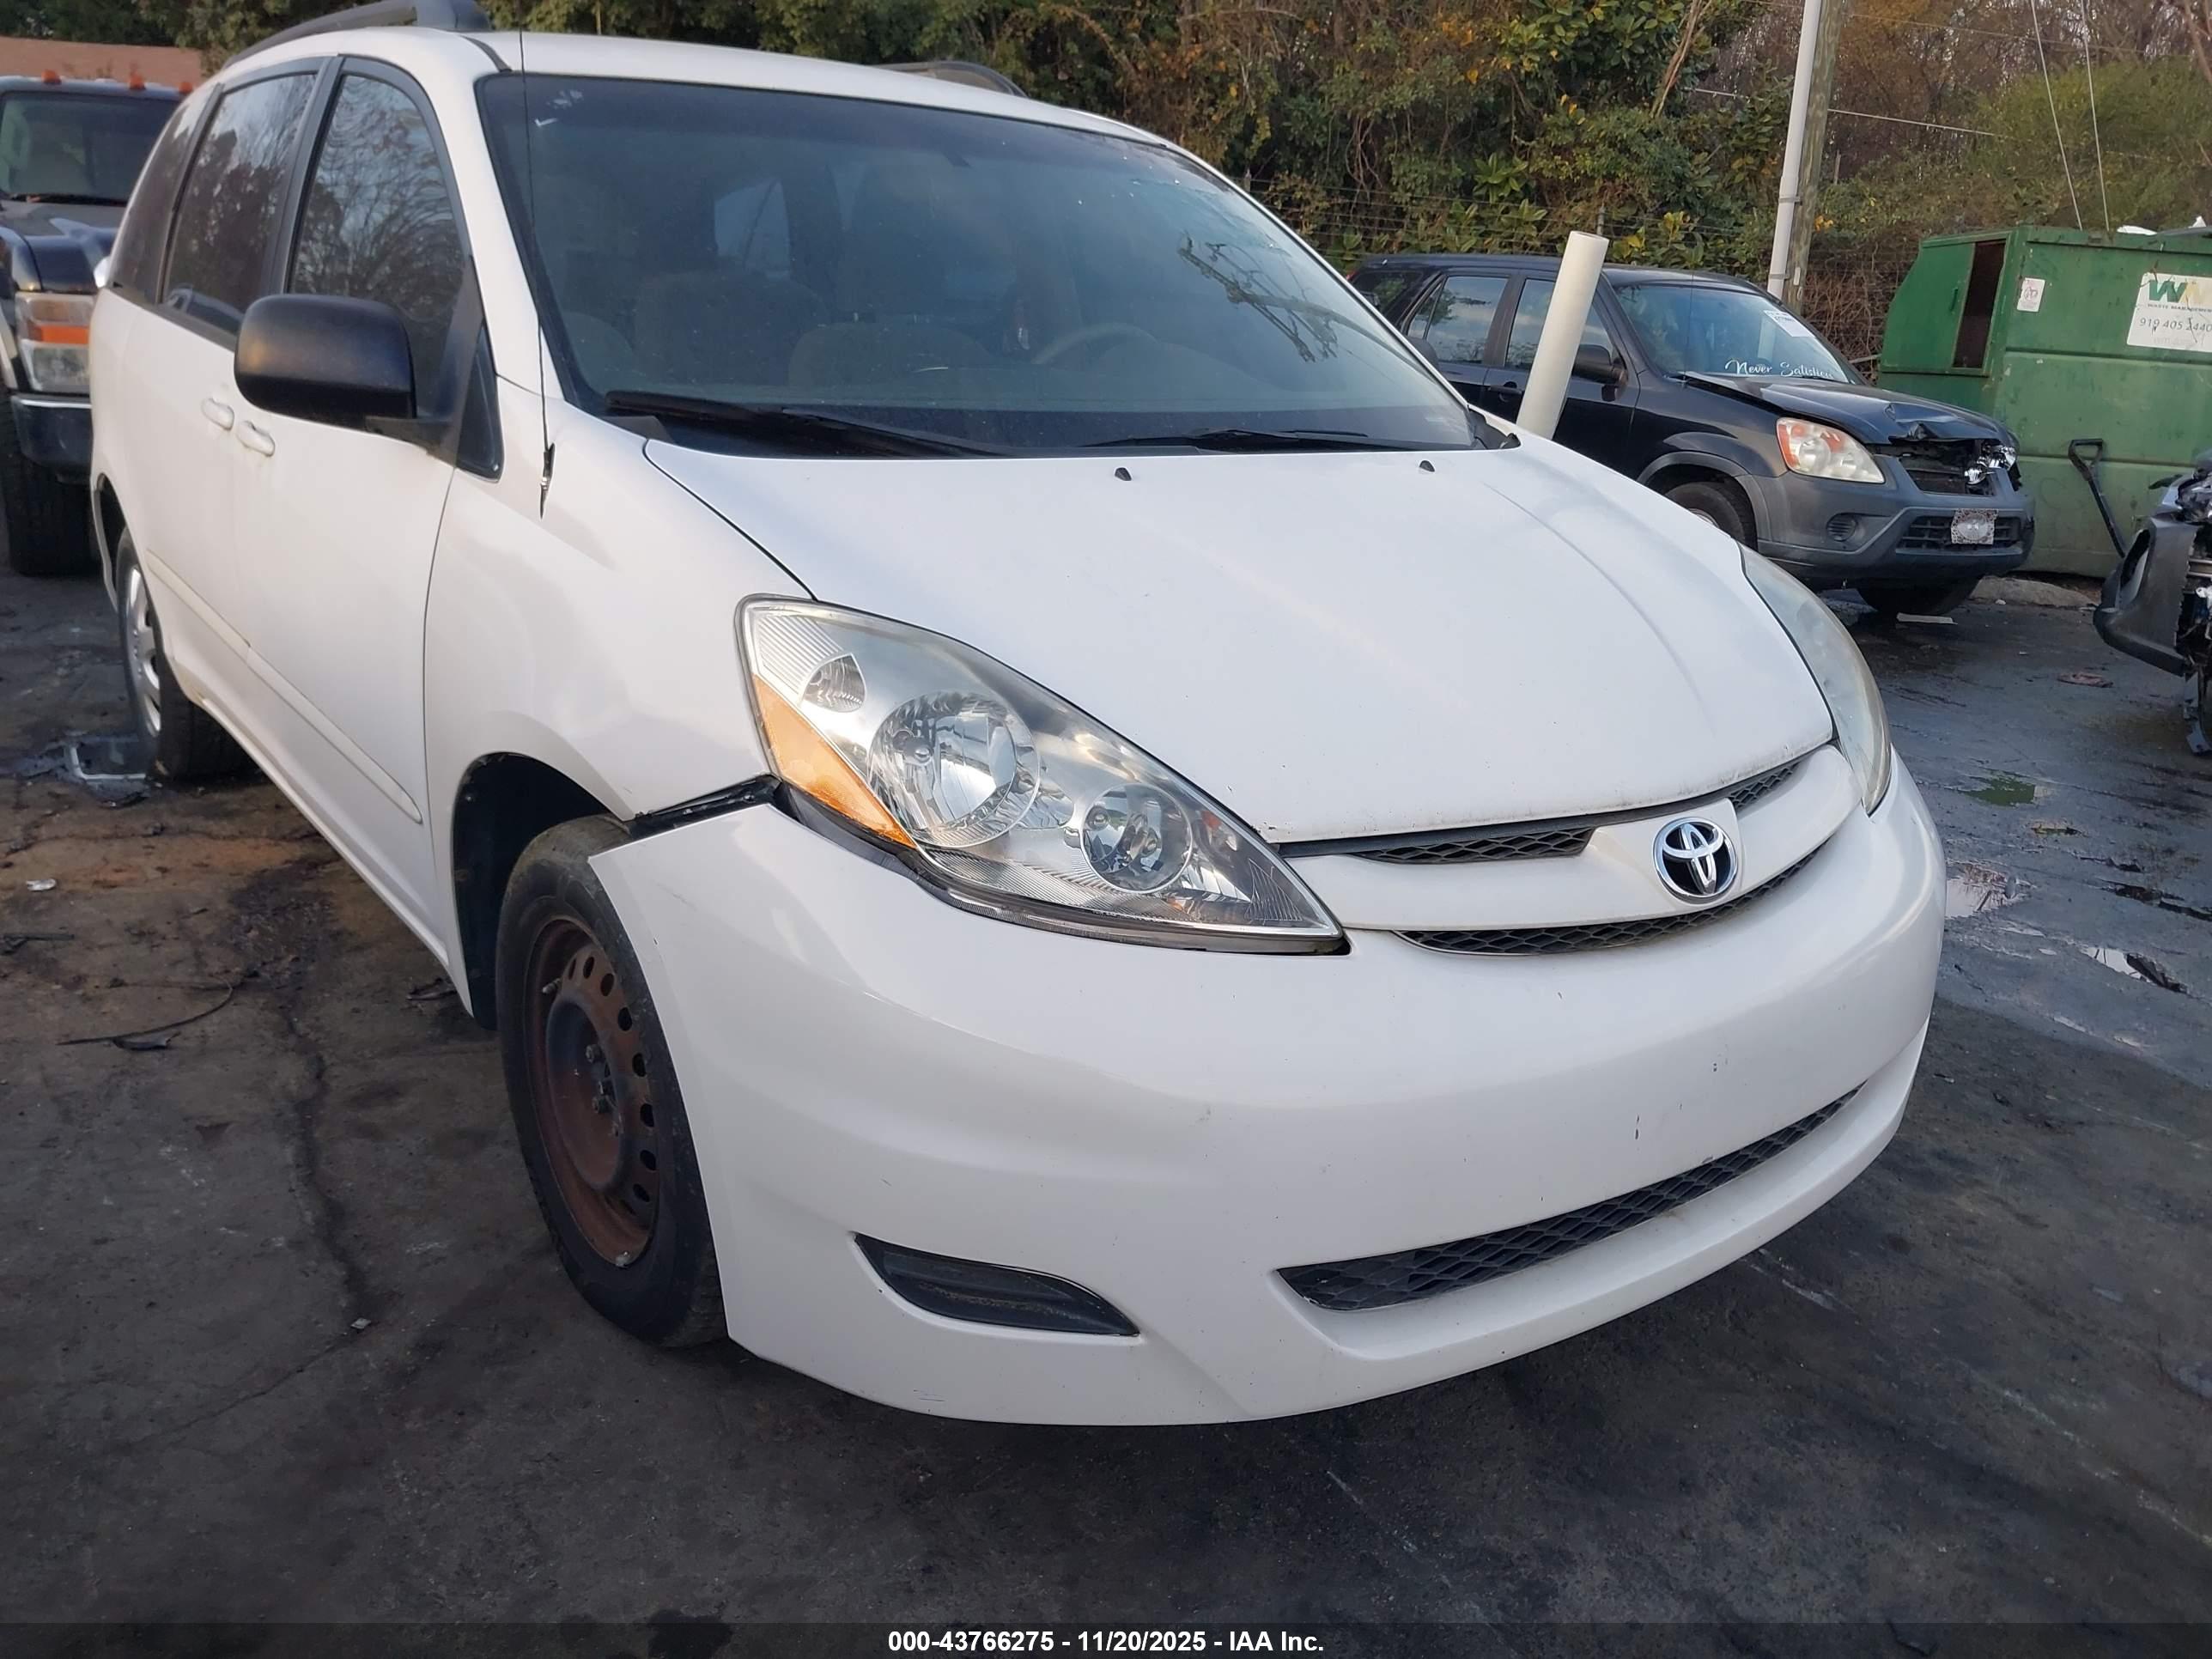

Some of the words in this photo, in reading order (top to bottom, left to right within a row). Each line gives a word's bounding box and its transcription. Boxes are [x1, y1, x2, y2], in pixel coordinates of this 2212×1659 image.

[2140, 317, 2160, 328] 919
[2162, 319, 2183, 331] 405
[1725, 359, 1772, 374] Never
